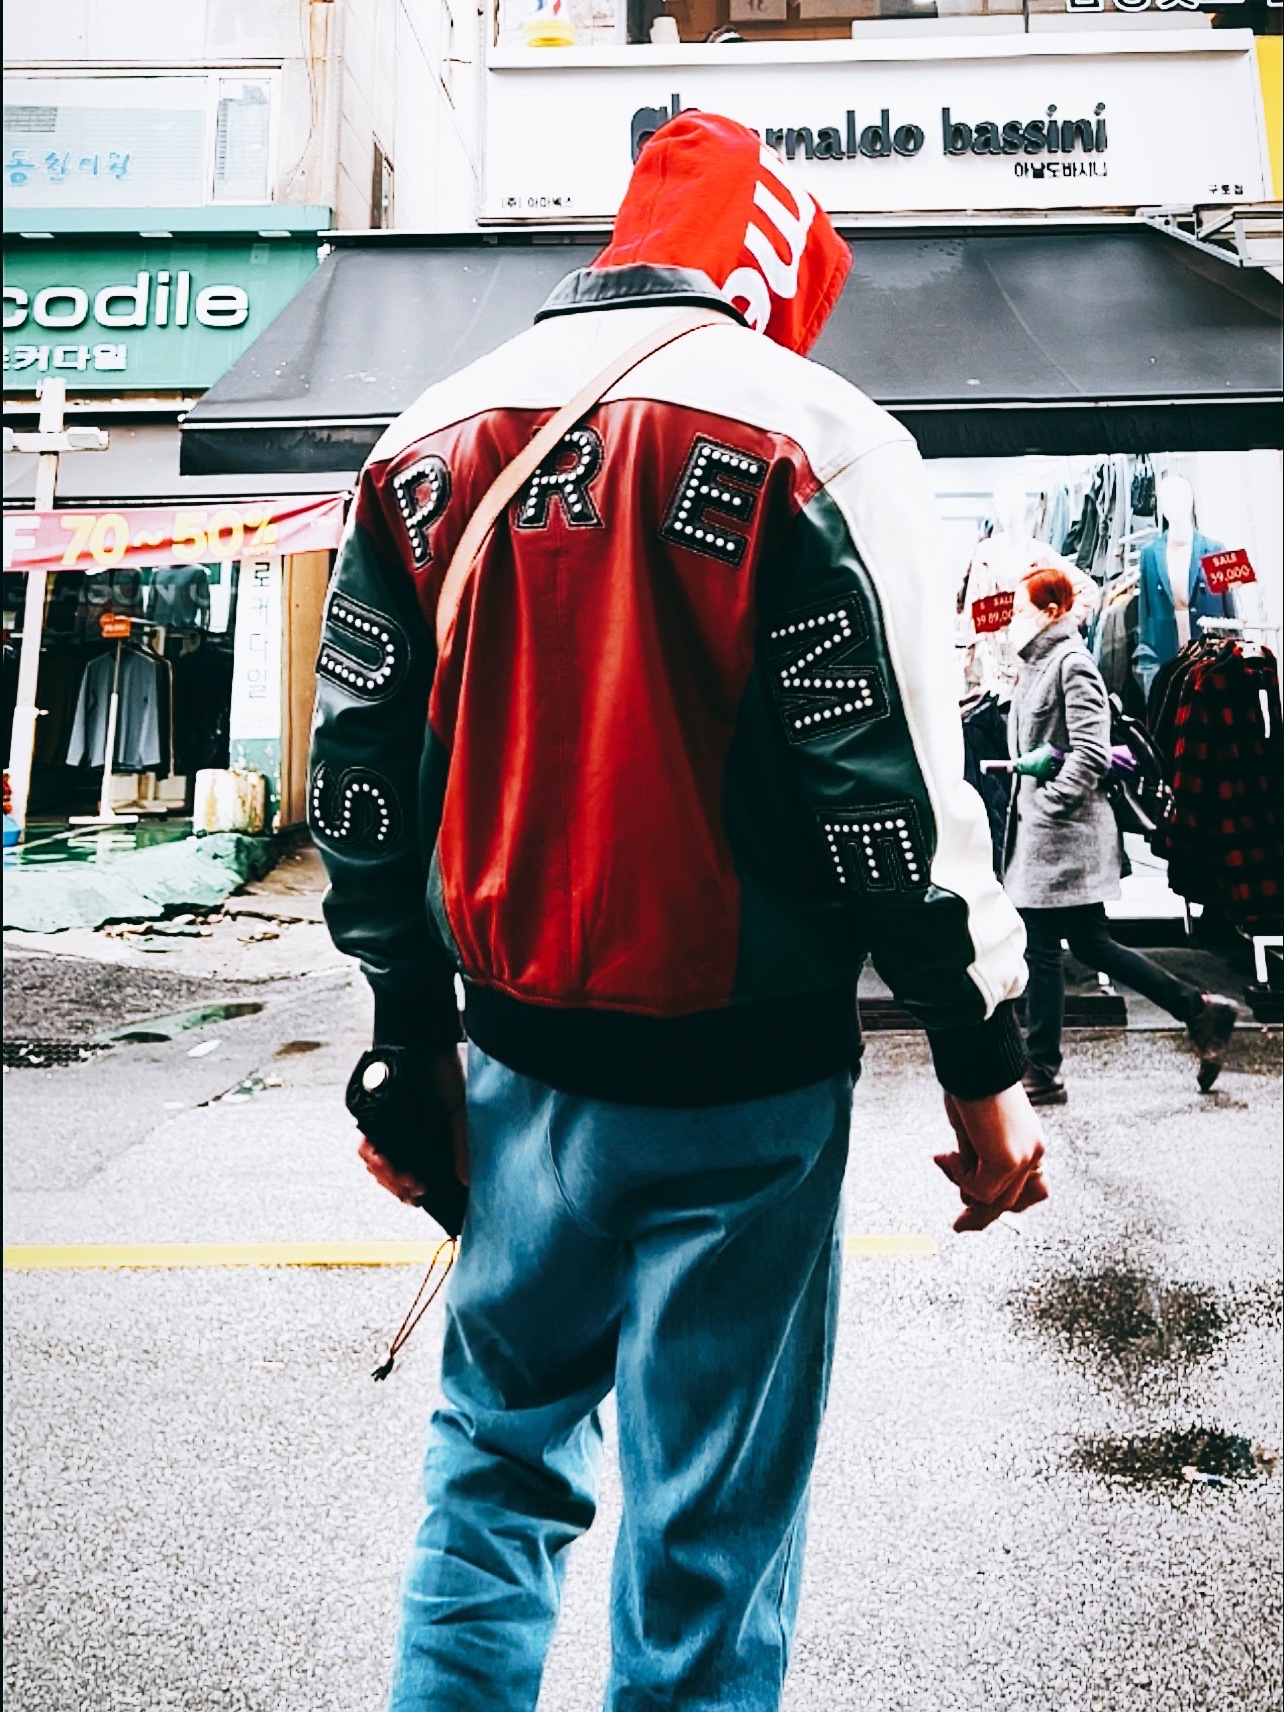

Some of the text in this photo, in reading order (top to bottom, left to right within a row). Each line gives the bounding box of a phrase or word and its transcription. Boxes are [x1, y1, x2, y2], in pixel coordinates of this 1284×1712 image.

[750, 102, 1108, 160] rnaldo bassini
[3, 344, 127, 371] 커다일
